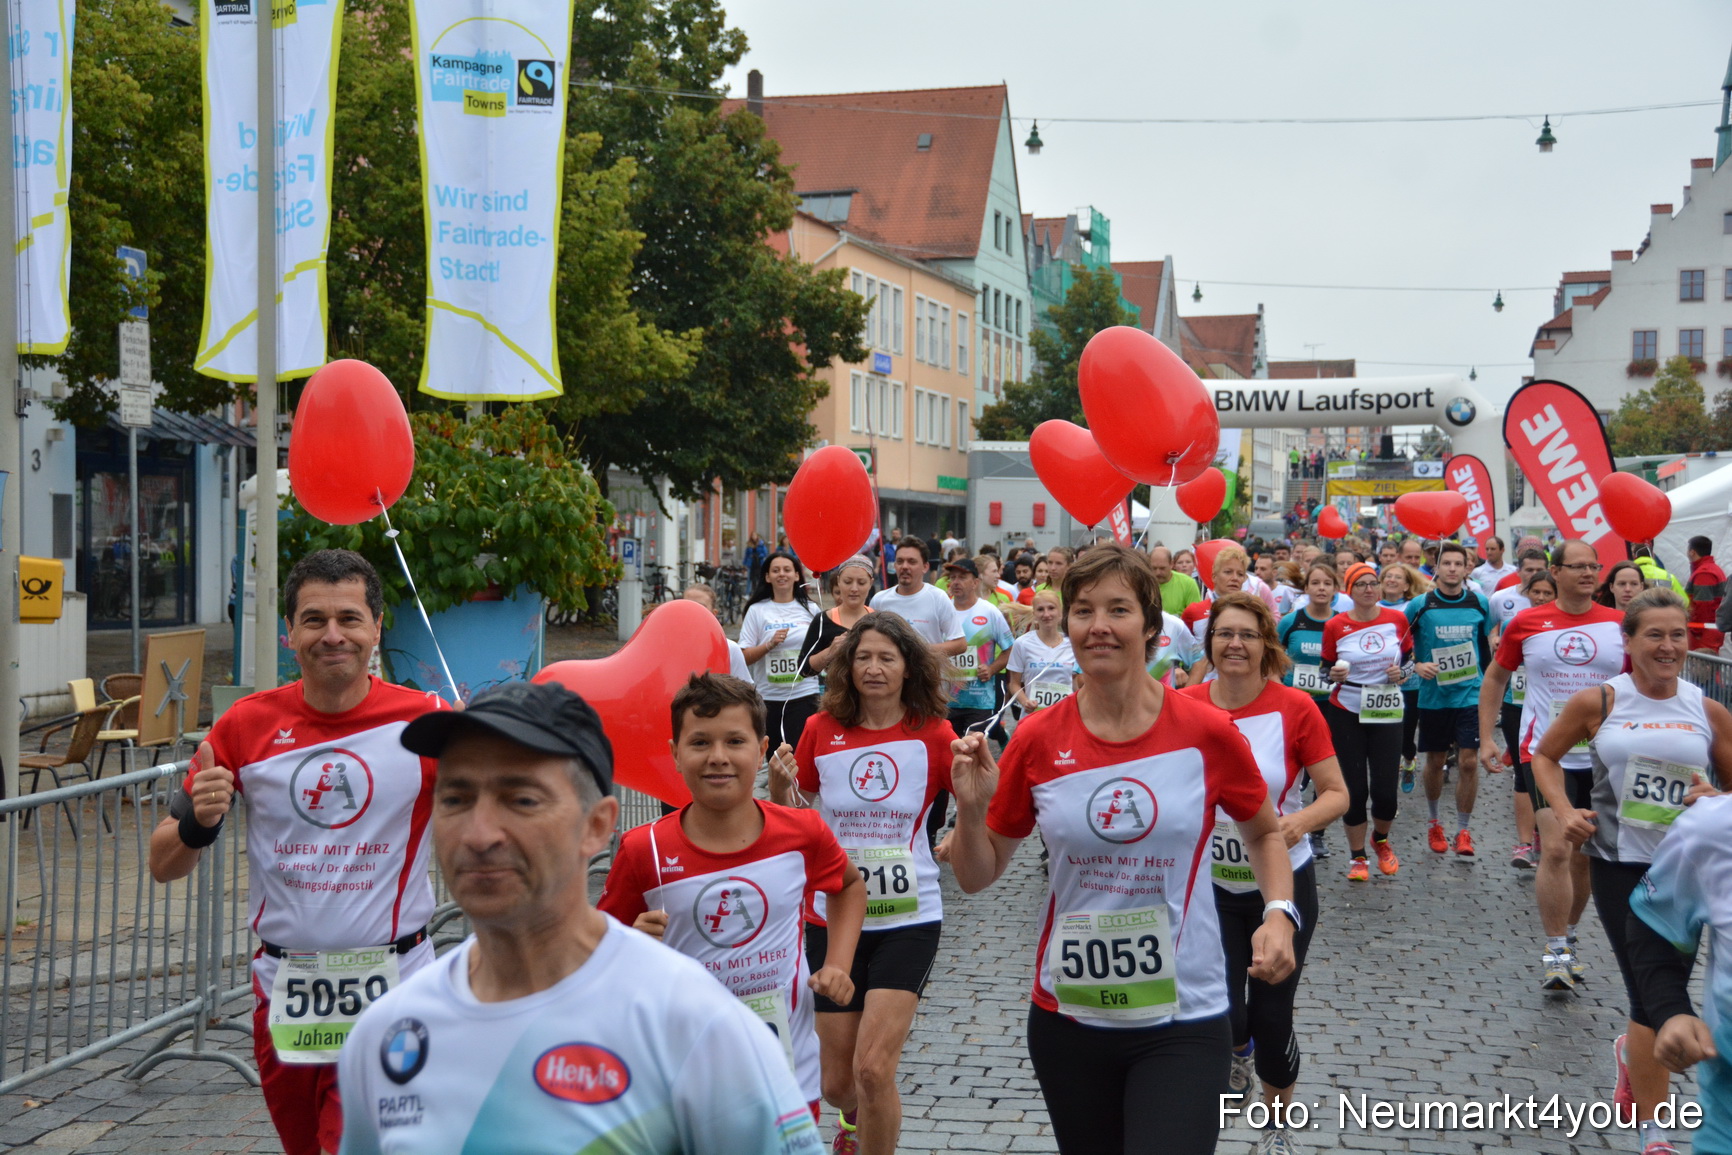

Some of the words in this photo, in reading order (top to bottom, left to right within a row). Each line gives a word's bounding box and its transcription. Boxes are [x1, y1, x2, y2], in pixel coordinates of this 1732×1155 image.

[432, 56, 503, 76] Kampagne
[432, 69, 511, 91] Fairtrade
[465, 95, 505, 111] Towns
[518, 97, 553, 105] FAIRTRADE
[434, 184, 478, 209] Wir
[482, 189, 528, 212] sind
[438, 221, 546, 247] Fairtrade-
[1214, 390, 1289, 412] BMW
[1298, 387, 1434, 414] Laufsport
[31, 449, 41, 471] 3
[1520, 403, 1612, 545] REWE
[1373, 483, 1399, 493] ZIEL
[1452, 463, 1490, 535] REWE
[1112, 504, 1129, 542] RE
[770, 659, 797, 673] 505
[1438, 651, 1472, 671] 5157
[1366, 693, 1400, 708] 5055
[1632, 773, 1695, 806] 530
[832, 809, 866, 818] LAUFEN
[890, 810, 913, 820] HERZ
[323, 844, 350, 856] MIT
[355, 842, 390, 856] HERZ
[863, 848, 903, 860] BOCK
[278, 862, 291, 871] Dr.
[293, 862, 317, 872] Heck
[326, 862, 341, 873] Dr.
[343, 861, 376, 872] Röschl
[661, 865, 684, 873] erima
[1067, 855, 1112, 866] LAUFEN
[1118, 856, 1139, 867] MIT
[1144, 855, 1176, 868] HERZ
[857, 864, 910, 896] 218
[1093, 868, 1115, 878] Heck
[1121, 872, 1132, 881] Dr.
[1134, 873, 1164, 882] Röschl
[284, 876, 374, 894] Leistungsdiagnostik
[1079, 880, 1163, 896] Leistungsdiagnostik
[1098, 910, 1158, 929] BOCK
[326, 951, 385, 966] BOCK
[727, 956, 752, 969] MIT
[758, 948, 788, 965] HERZ
[1062, 934, 1163, 979] 5053
[732, 974, 747, 984] Dr.
[750, 967, 779, 981] Röschl
[1100, 990, 1129, 1006] Eva
[293, 1029, 349, 1046] Johan
[545, 1055, 620, 1091] Hervis
[379, 1094, 425, 1113] PARTL
